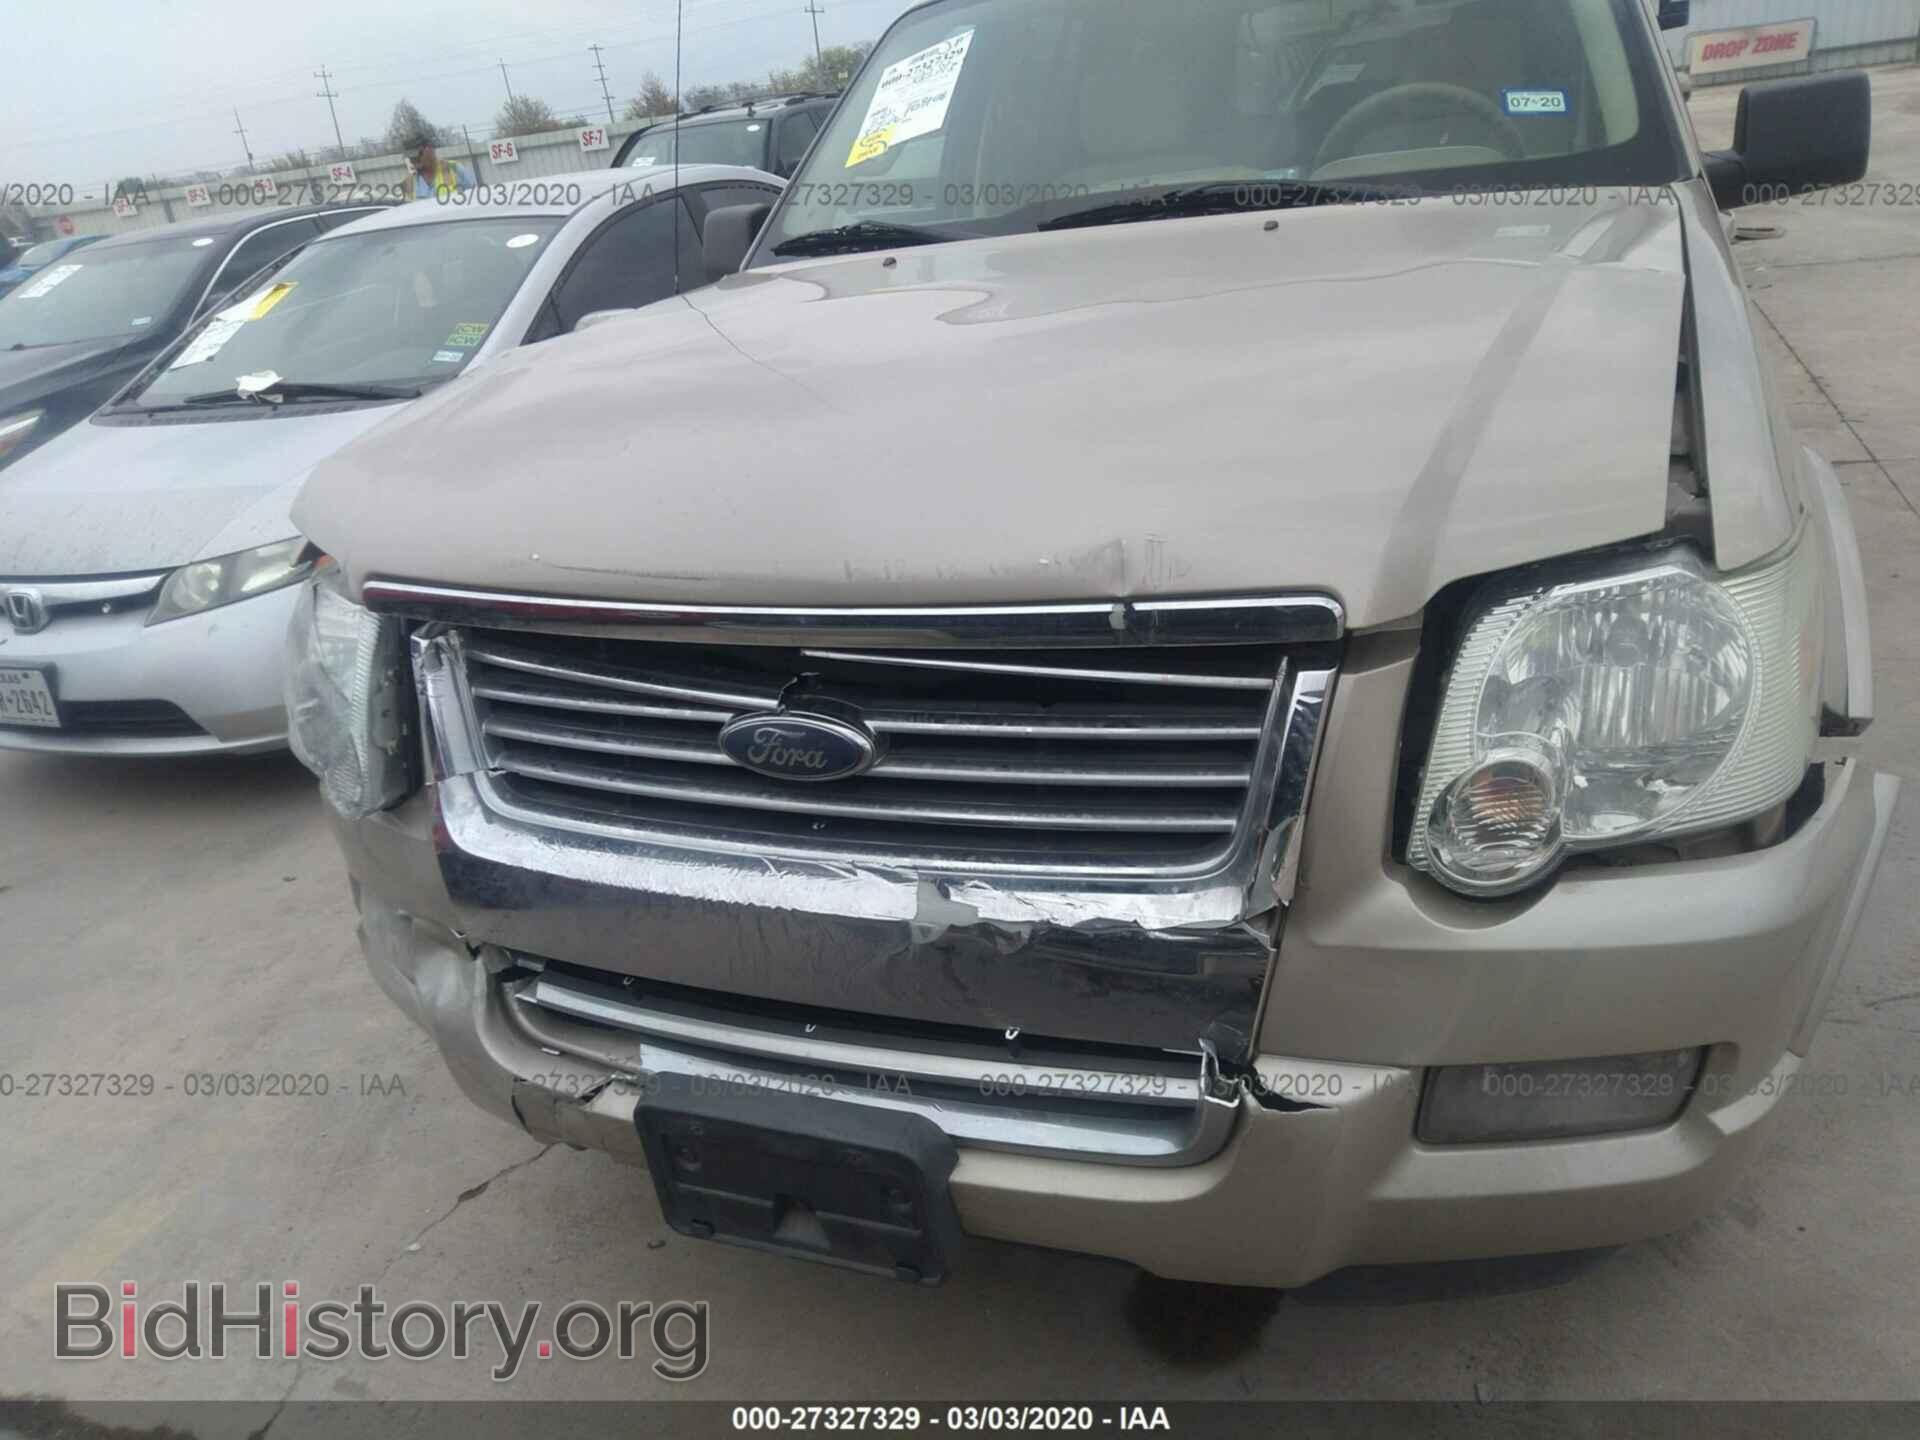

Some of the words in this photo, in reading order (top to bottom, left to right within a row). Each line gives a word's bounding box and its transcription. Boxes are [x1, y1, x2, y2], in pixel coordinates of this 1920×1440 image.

[1702, 40, 1749, 62] DROP
[1752, 32, 1799, 54] ZONE
[1510, 96, 1561, 108] 07-20
[582, 129, 604, 146] SF-7
[491, 143, 514, 159] SF-6
[748, 727, 828, 769] Ford
